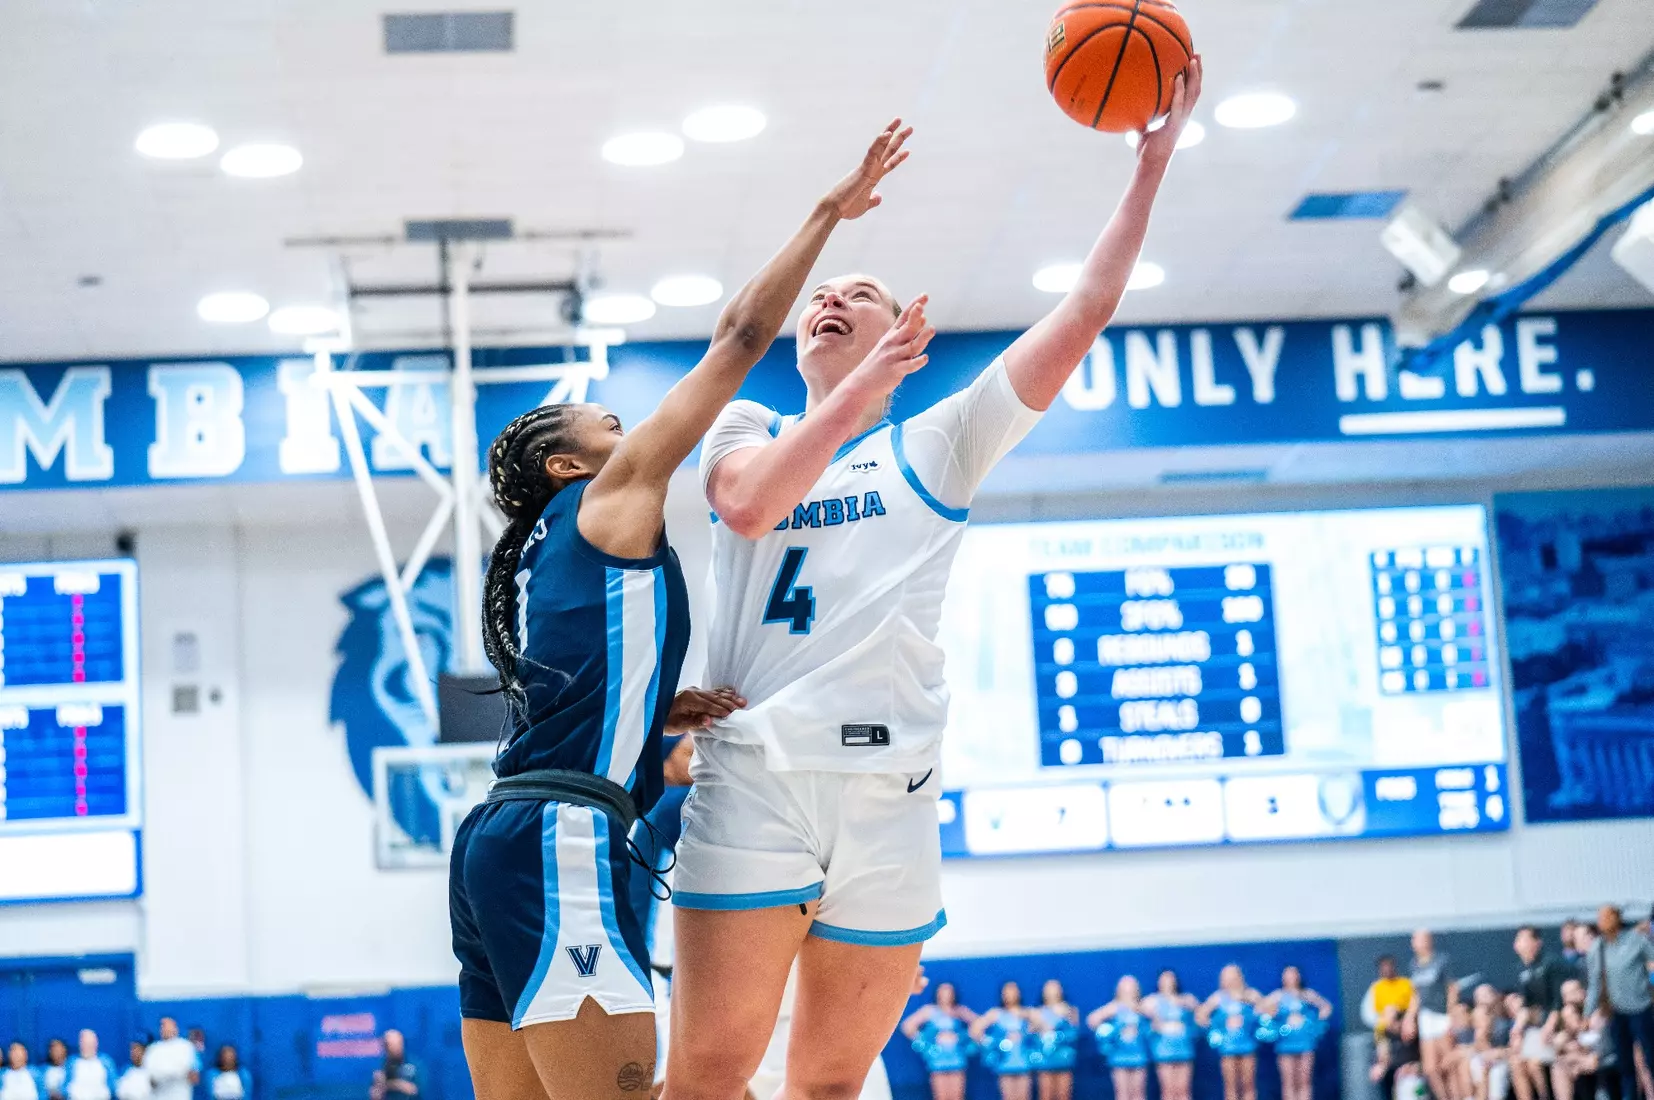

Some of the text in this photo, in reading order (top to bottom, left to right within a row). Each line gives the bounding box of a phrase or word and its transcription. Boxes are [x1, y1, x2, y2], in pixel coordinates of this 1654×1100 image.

[1060, 325, 1284, 411] ONLY
[762, 546, 817, 635] 4
[876, 730, 884, 740] L
[566, 944, 602, 977] V
